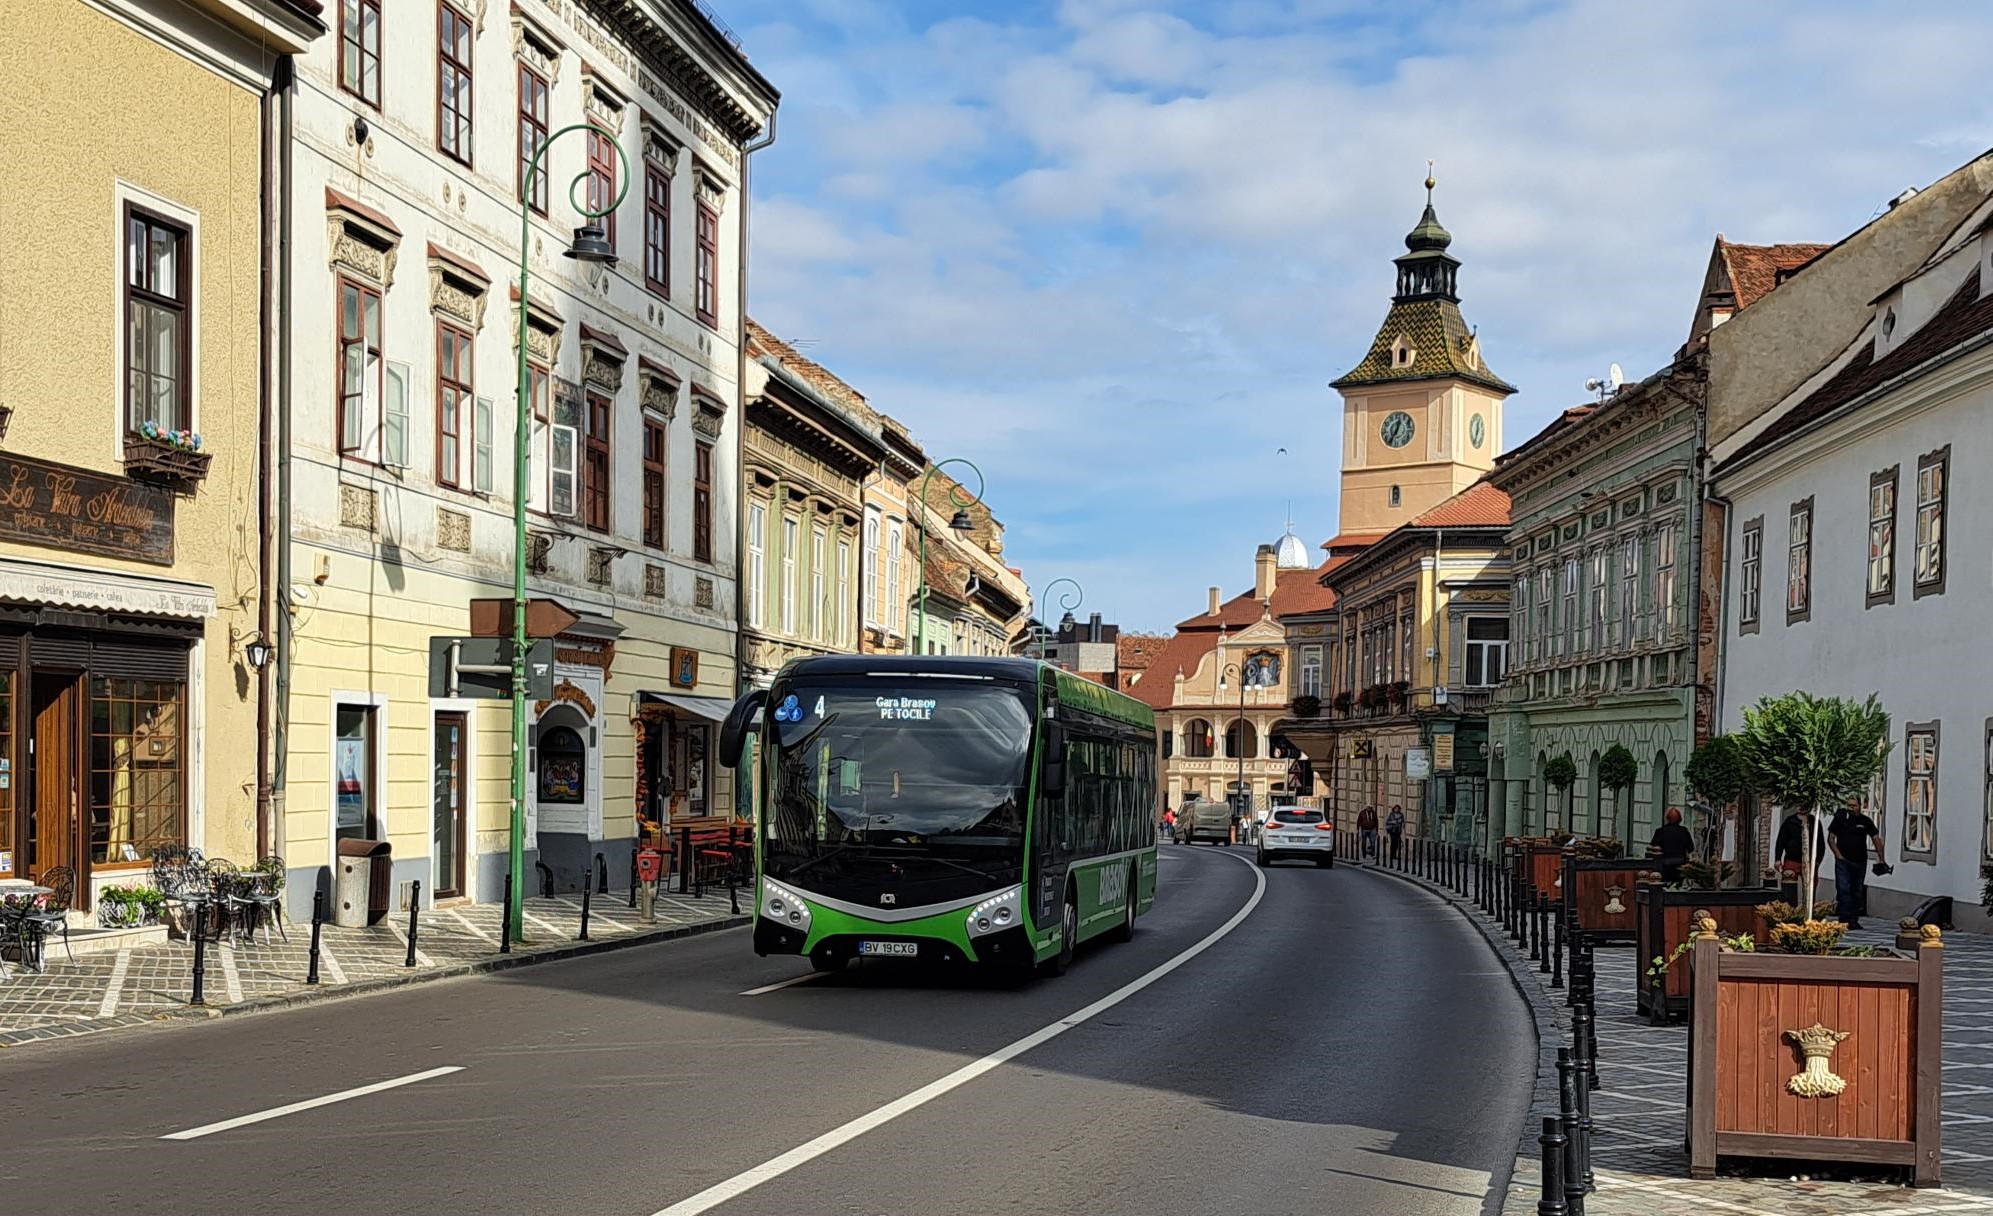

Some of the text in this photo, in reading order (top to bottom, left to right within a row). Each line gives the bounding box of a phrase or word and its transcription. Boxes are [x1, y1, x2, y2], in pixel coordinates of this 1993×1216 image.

[814, 695, 825, 719] 4
[876, 696, 899, 708] Gara
[881, 708, 931, 720] PE TOCILE
[865, 943, 879, 953] BV
